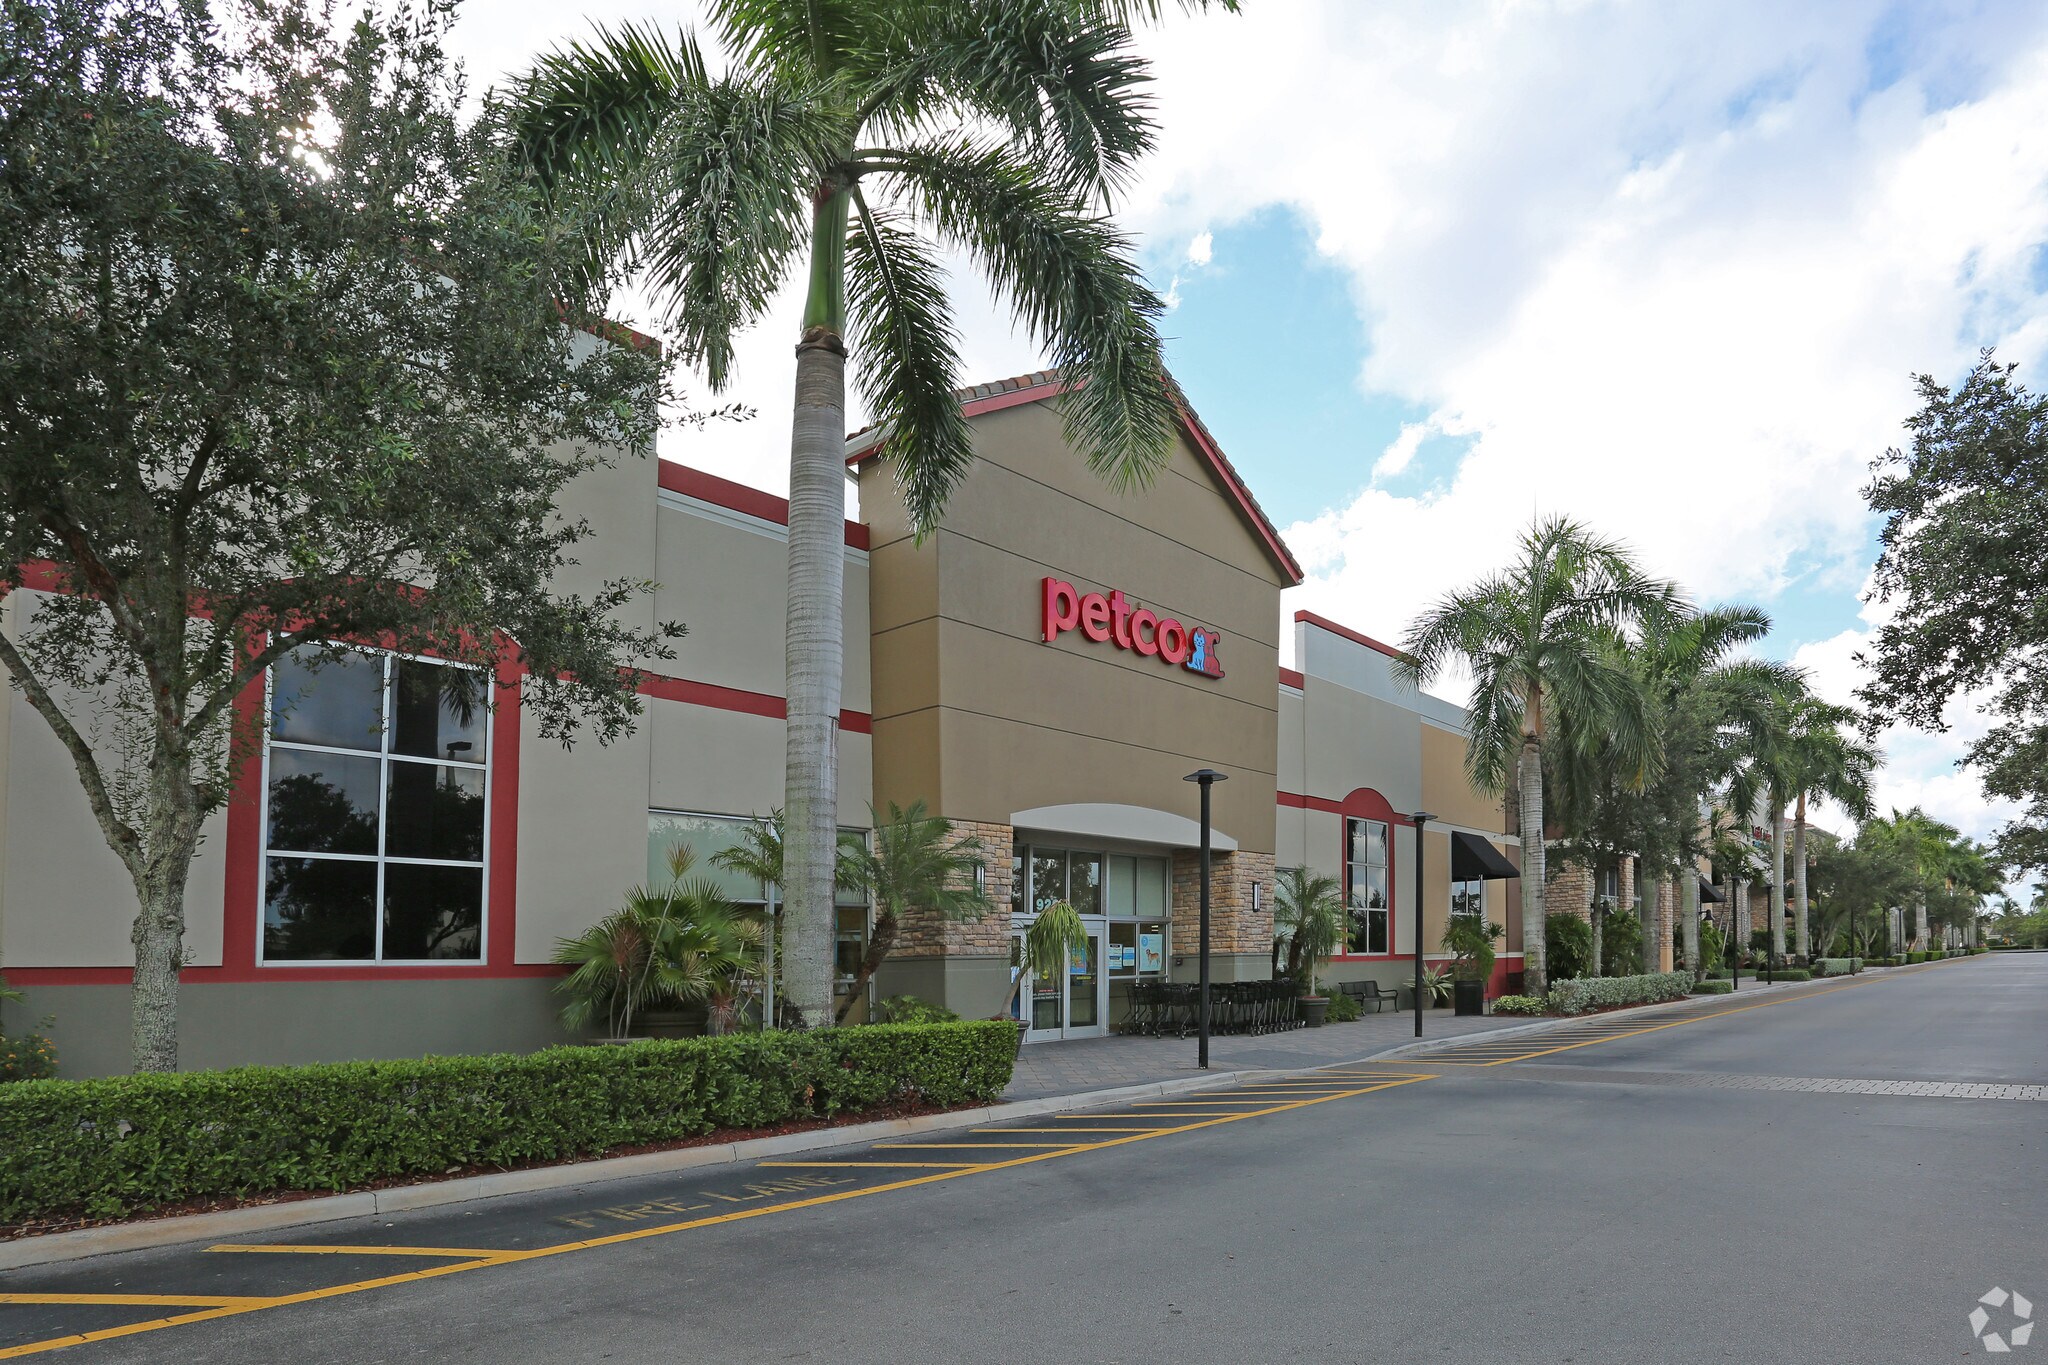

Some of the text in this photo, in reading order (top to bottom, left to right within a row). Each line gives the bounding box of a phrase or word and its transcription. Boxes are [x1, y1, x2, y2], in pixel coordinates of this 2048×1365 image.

[1041, 576, 1188, 665] petco
[551, 1173, 857, 1229] FIRE LANE
